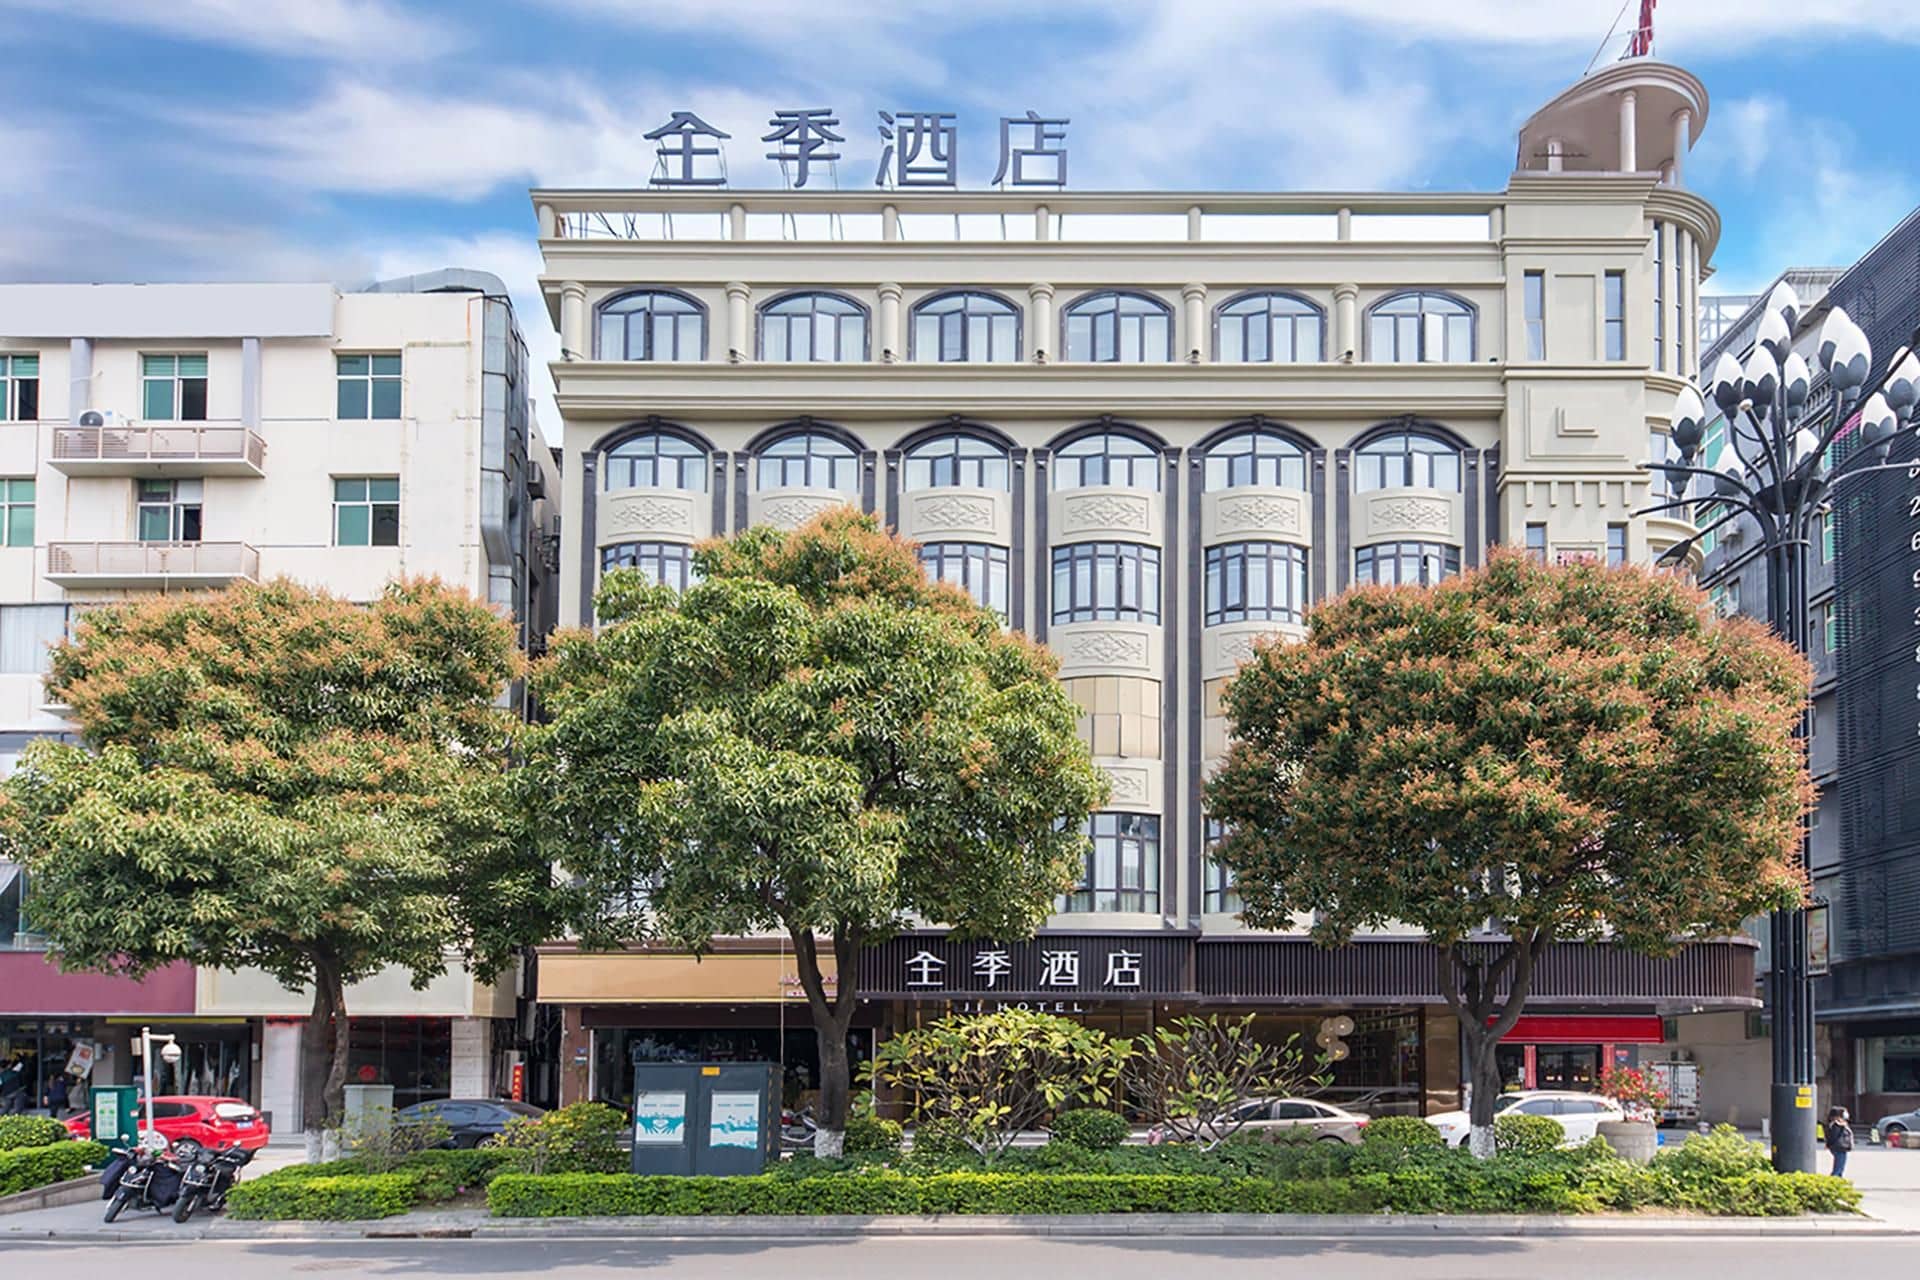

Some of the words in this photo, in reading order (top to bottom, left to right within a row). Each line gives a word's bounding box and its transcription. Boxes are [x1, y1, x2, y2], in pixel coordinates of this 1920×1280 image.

[643, 109, 1070, 188] 全季酒店
[905, 950, 1142, 987] 全季酒店
[997, 1002, 1083, 1012] HOTEL
